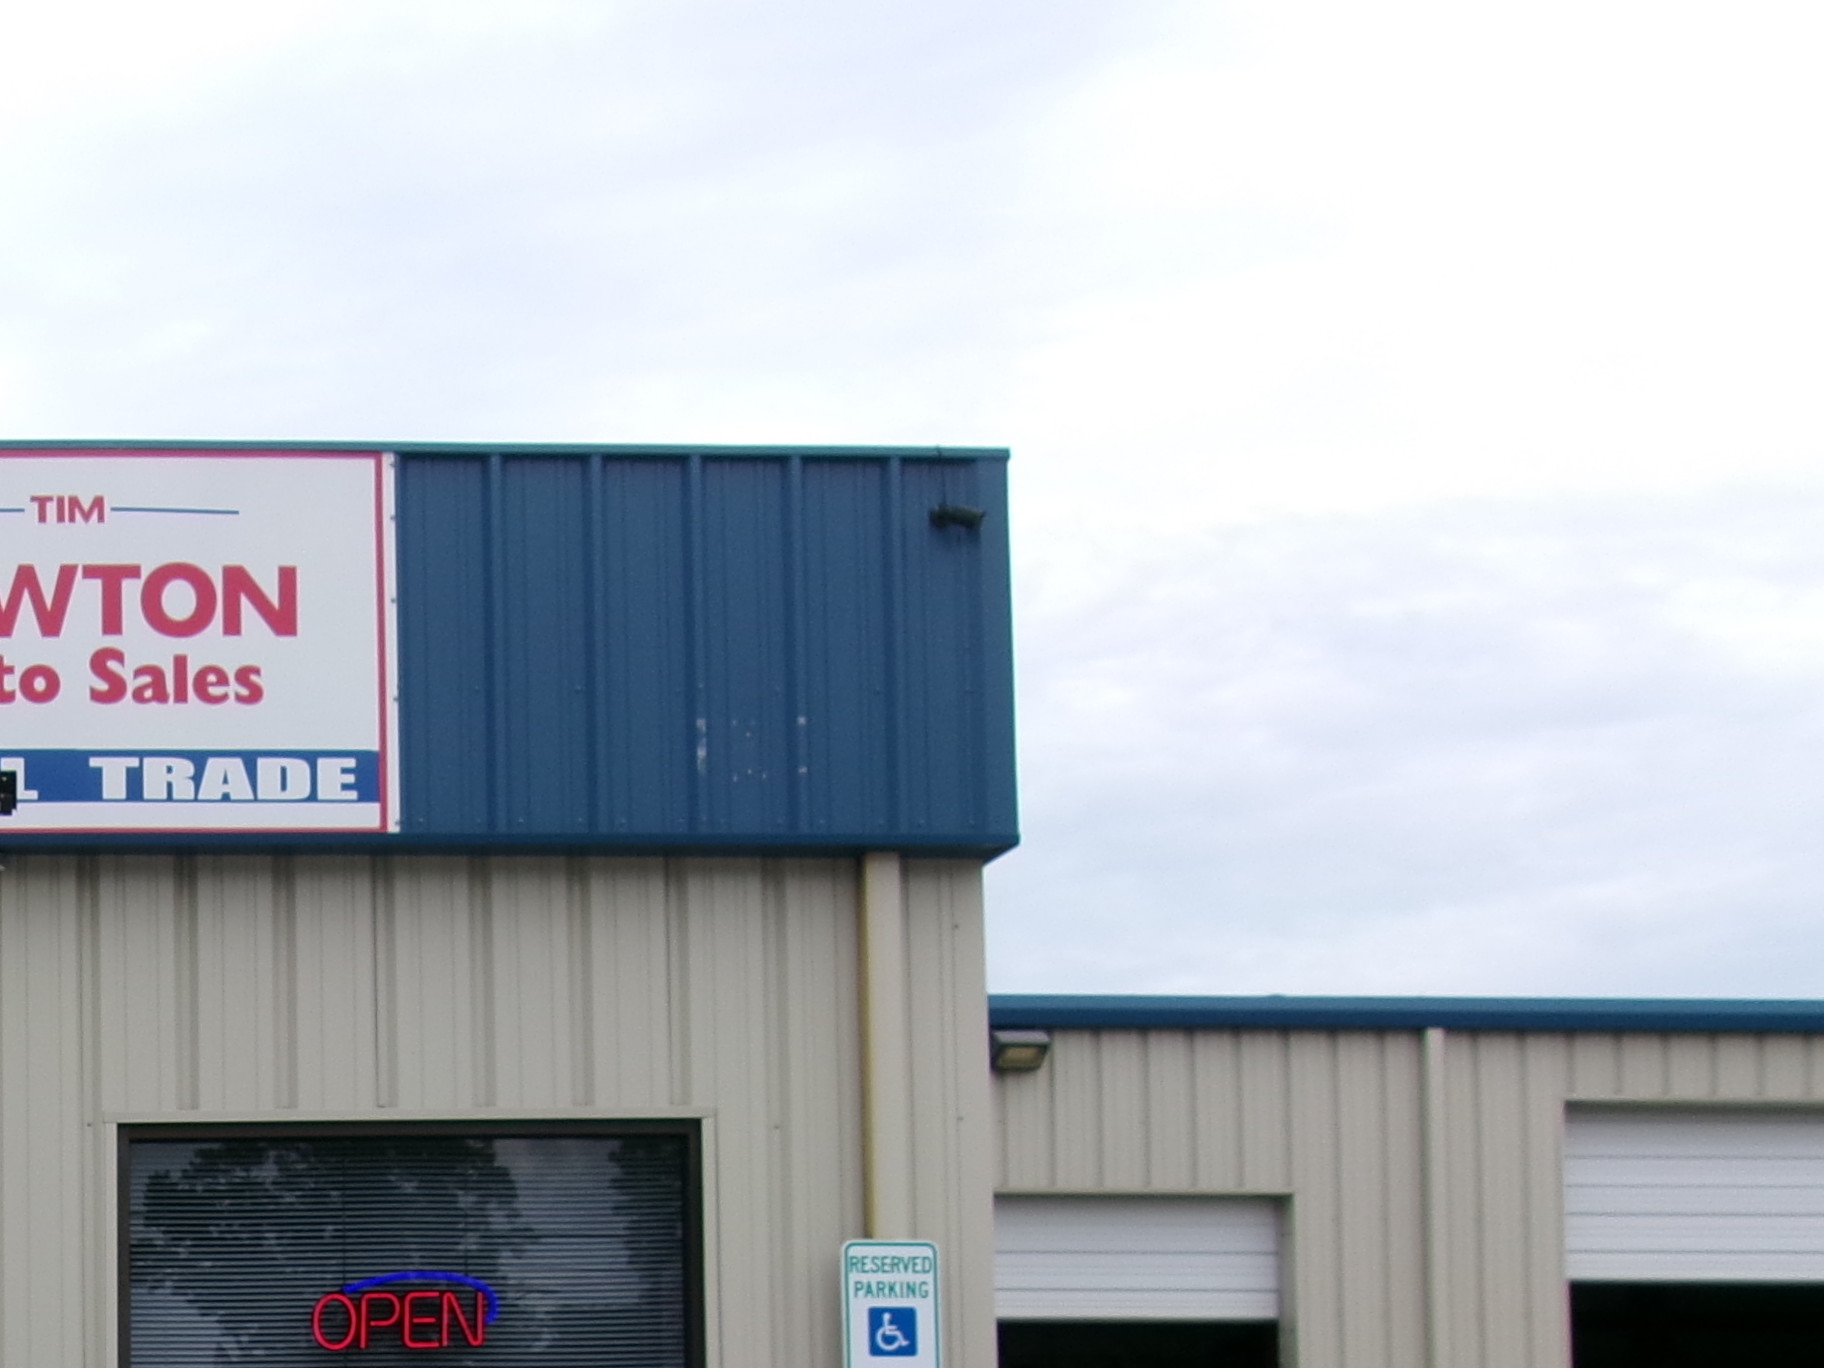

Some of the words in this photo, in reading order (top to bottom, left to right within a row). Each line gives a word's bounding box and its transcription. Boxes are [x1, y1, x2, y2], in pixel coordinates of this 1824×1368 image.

[30, 495, 105, 524] TIM
[88, 646, 265, 706] Sales
[88, 756, 359, 801] TRADE
[848, 1255, 933, 1275] RESERVED
[853, 1280, 930, 1299] PARKING
[311, 1290, 485, 1351] OPEN
